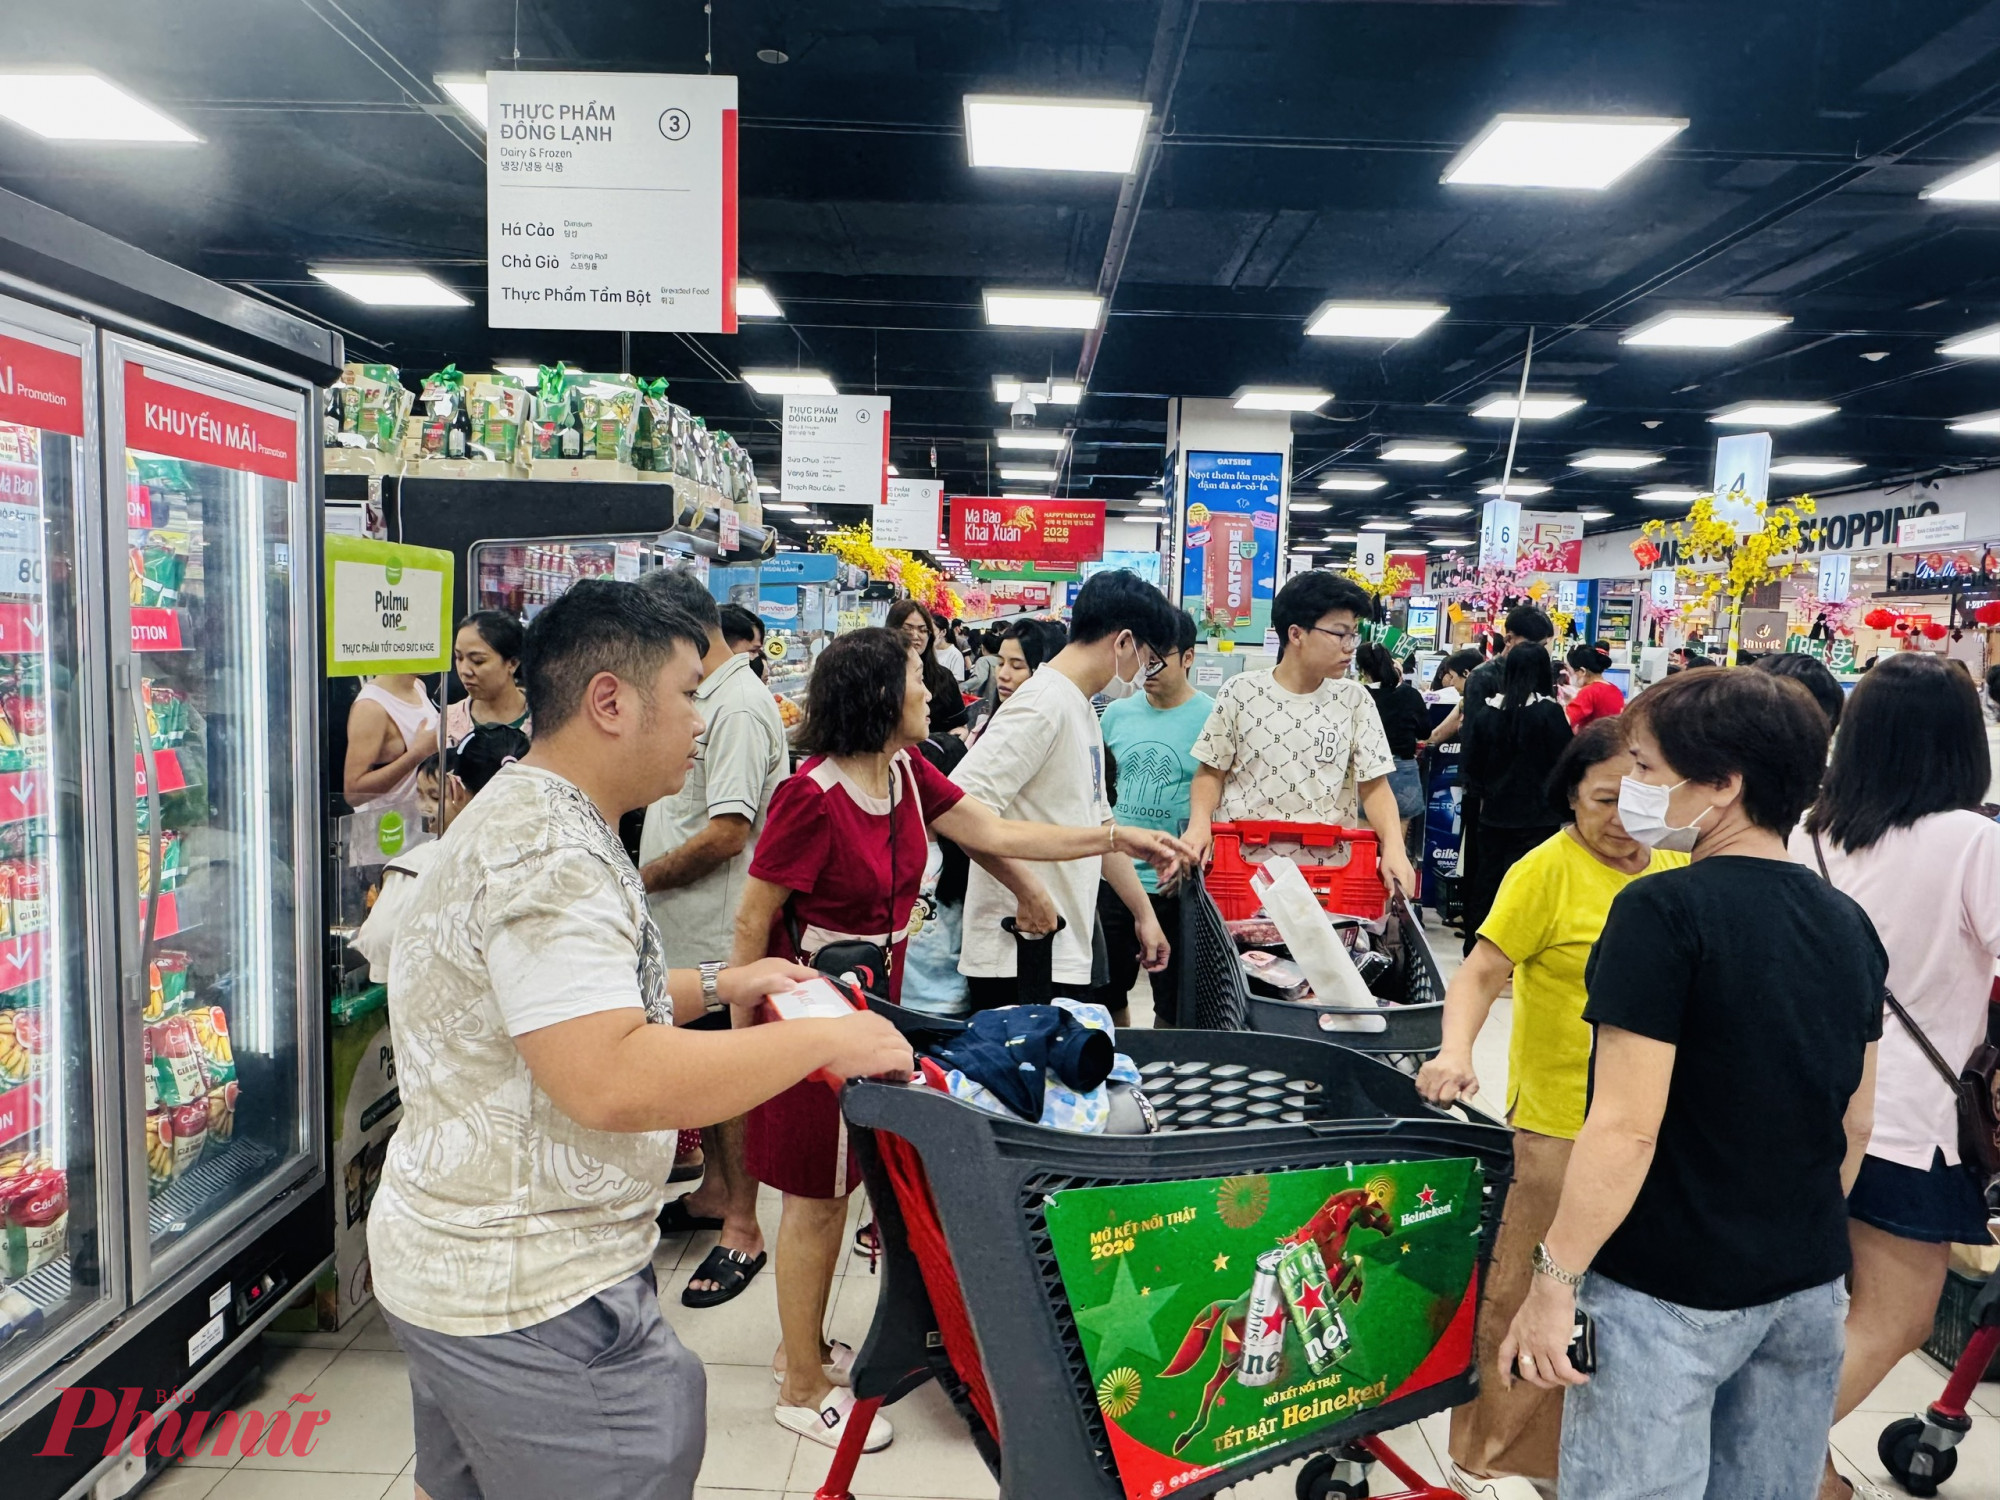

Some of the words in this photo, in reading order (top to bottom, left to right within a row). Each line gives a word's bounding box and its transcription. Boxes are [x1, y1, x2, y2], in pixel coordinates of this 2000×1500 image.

[500, 103, 555, 123] THỰC
[559, 100, 615, 121] PHẨM
[500, 121, 556, 141] ĐÔNG
[561, 125, 612, 145] LẠNH
[668, 115, 681, 133] 3
[500, 147, 527, 159] Dairy
[529, 148, 537, 158] &
[539, 148, 573, 158] Frozen
[501, 221, 521, 236] Há
[525, 222, 555, 237] Cảo
[501, 253, 532, 268] Chả
[535, 254, 560, 269] Giò
[501, 287, 541, 304] Thực
[544, 285, 586, 302] Phẩm
[626, 289, 651, 306] Bột
[17, 383, 67, 406] Promotion
[860, 412, 866, 420] 4
[225, 422, 257, 453] MÃI
[1217, 458, 1252, 466] OATSIDE
[1188, 470, 1209, 480] Ngọt
[1211, 470, 1235, 480] thơm
[1197, 481, 1217, 491] đậm
[1218, 481, 1230, 490] đà
[964, 524, 989, 541] Khai
[1043, 527, 1069, 537] 2026
[1501, 526, 1510, 543] 6
[1365, 553, 1374, 566] 8
[1227, 530, 1243, 608] OATSIDE
[1659, 585, 1667, 596] 9
[375, 590, 409, 612] Pulmu
[382, 612, 402, 629] one
[1314, 726, 1341, 764] B
[1131, 805, 1172, 819] WOODS
[1400, 1203, 1452, 1227] Heineken
[1090, 1226, 1112, 1245] MỞ
[1114, 1219, 1139, 1238] KẾT
[1141, 1213, 1164, 1232] NỐI
[1166, 1206, 1197, 1226] THẬT
[1091, 1237, 1135, 1260] 2026
[1248, 1298, 1266, 1341] SILVER
[1280, 1386, 1298, 1400] KẾT
[1317, 1373, 1342, 1390] THẬT
[1213, 1425, 1244, 1452] TẾT
[1247, 1415, 1278, 1441] BẬT
[1282, 1378, 1387, 1430] Heineken
